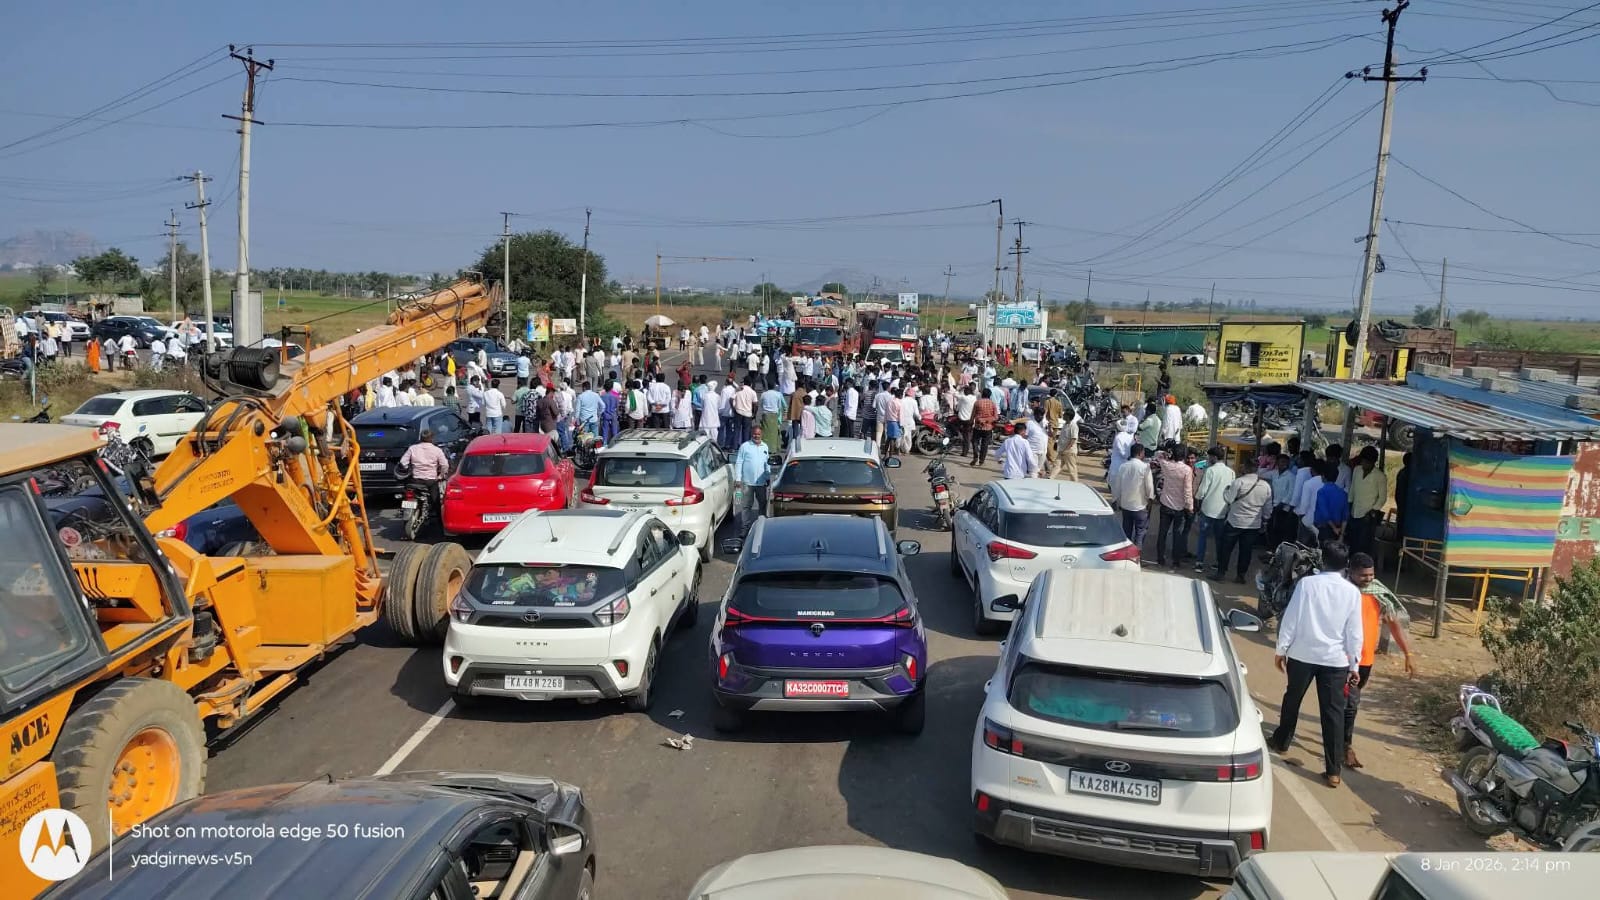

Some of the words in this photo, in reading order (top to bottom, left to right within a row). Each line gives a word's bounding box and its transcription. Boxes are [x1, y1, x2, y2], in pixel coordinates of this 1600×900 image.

[510, 677, 521, 687] KA
[11, 714, 50, 755] ACE
[1078, 776, 1159, 798] KA28MA4518
